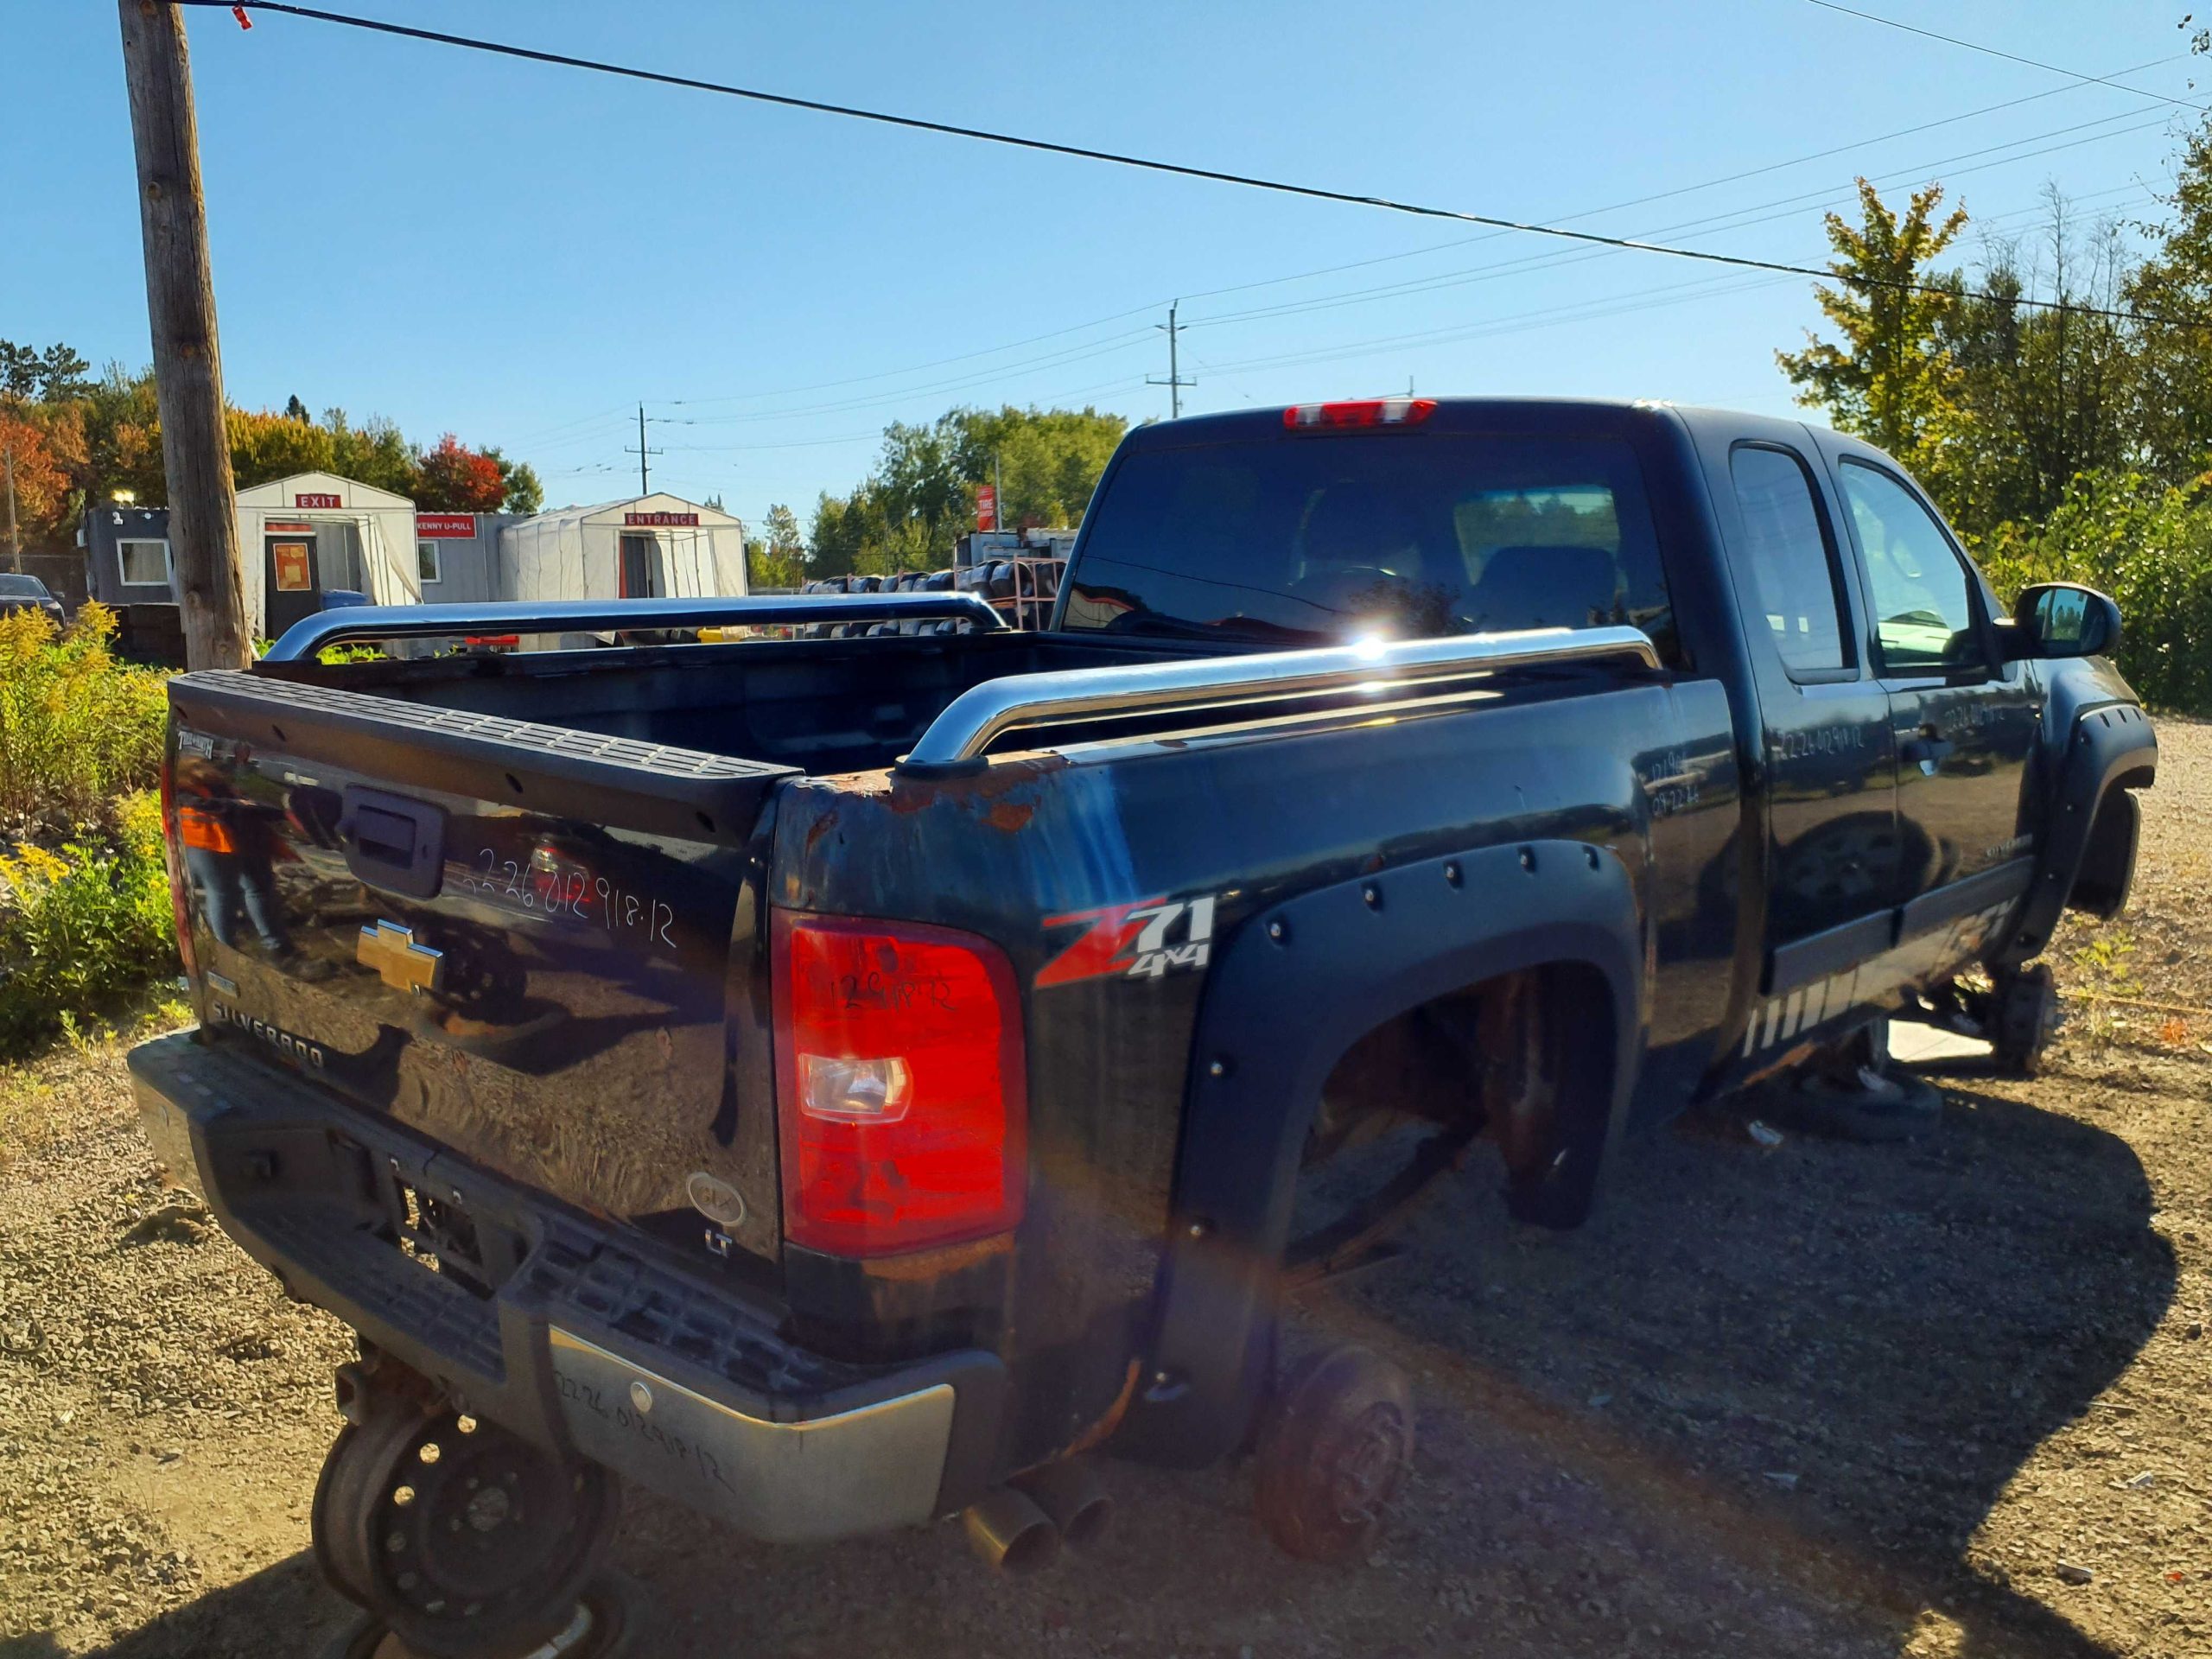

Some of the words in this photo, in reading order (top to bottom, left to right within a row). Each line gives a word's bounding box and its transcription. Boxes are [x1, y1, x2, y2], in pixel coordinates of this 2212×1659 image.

[301, 496, 336, 507] EXIT
[627, 514, 696, 525] ENTRANCE
[1036, 896, 1215, 989] Z71
[213, 1000, 325, 1070] SILVERADO
[704, 1228, 734, 1258] LT
